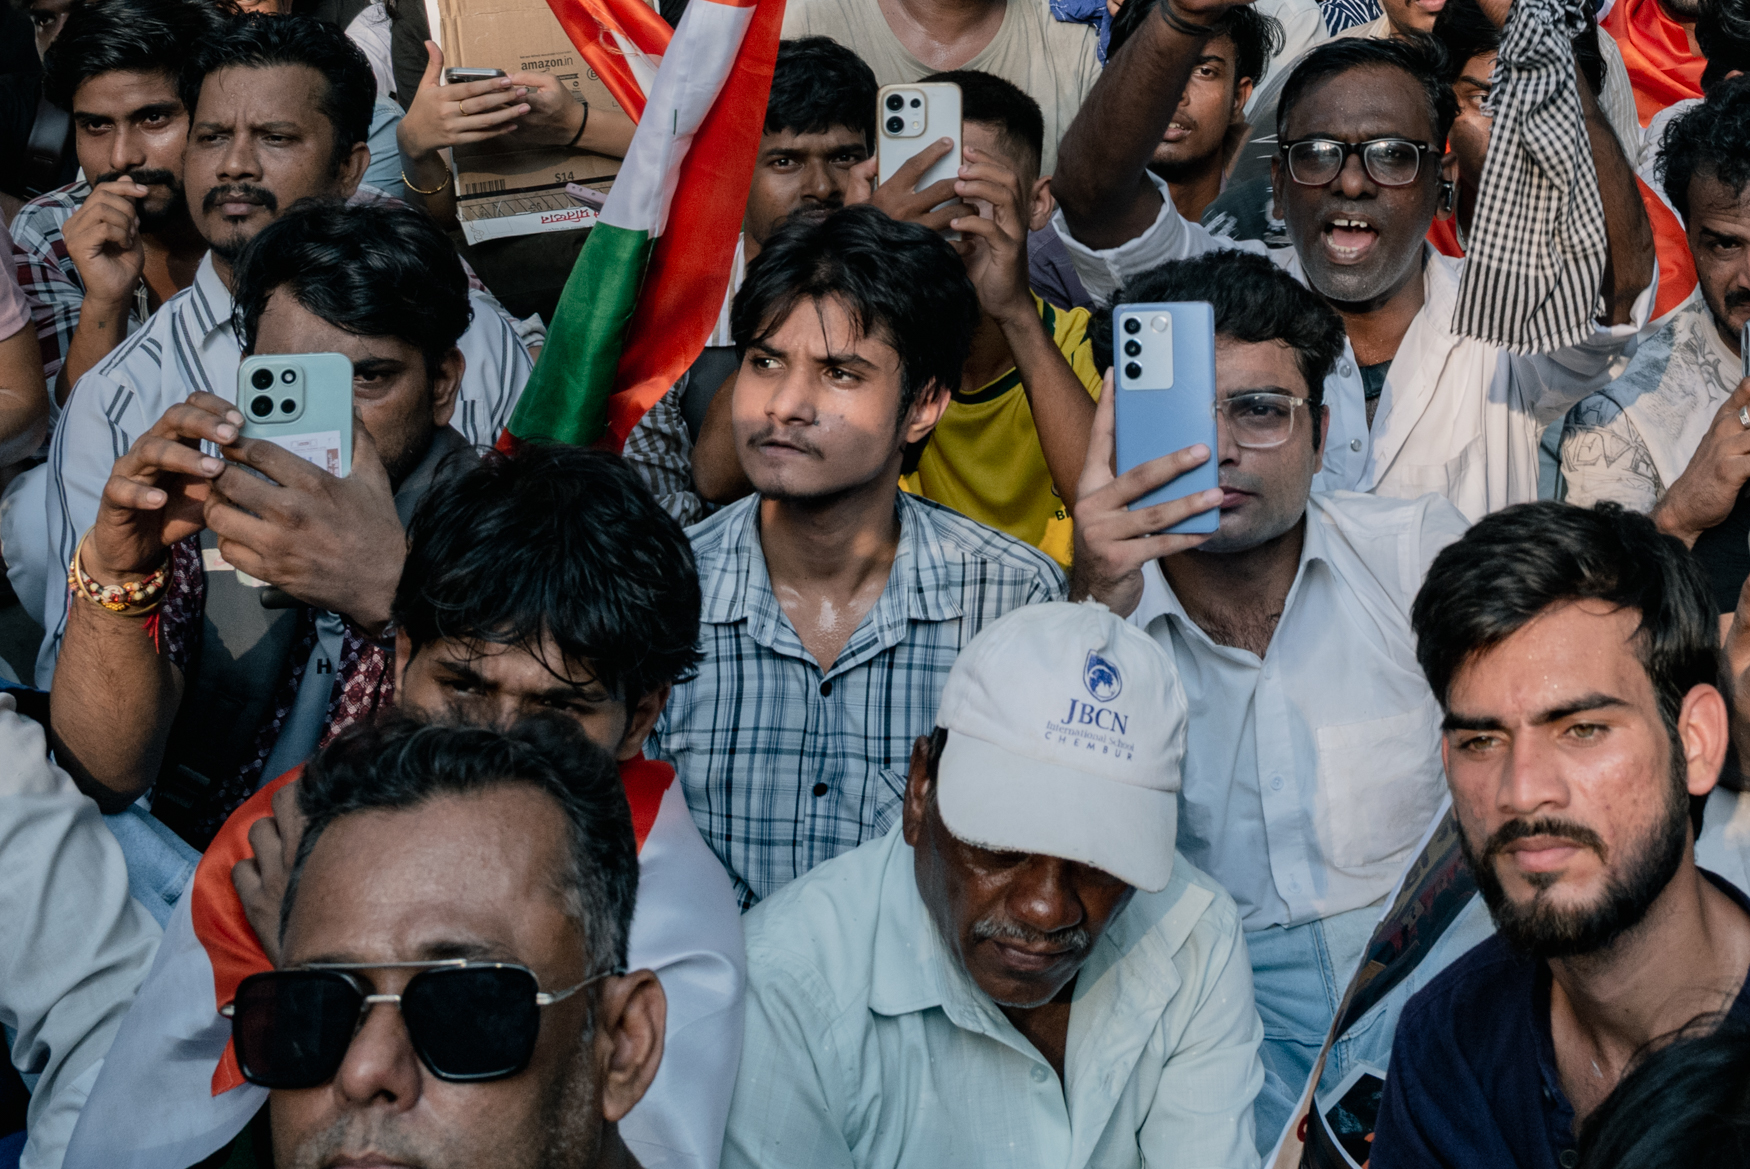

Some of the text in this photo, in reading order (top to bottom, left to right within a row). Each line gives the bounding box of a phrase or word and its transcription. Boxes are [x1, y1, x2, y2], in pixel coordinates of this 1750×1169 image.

[521, 56, 574, 71] amazon.in
[554, 171, 575, 183] S14
[1060, 698, 1129, 735] JBCN
[1044, 731, 1133, 761] CHEMBUR
[1046, 720, 1135, 752] International School
